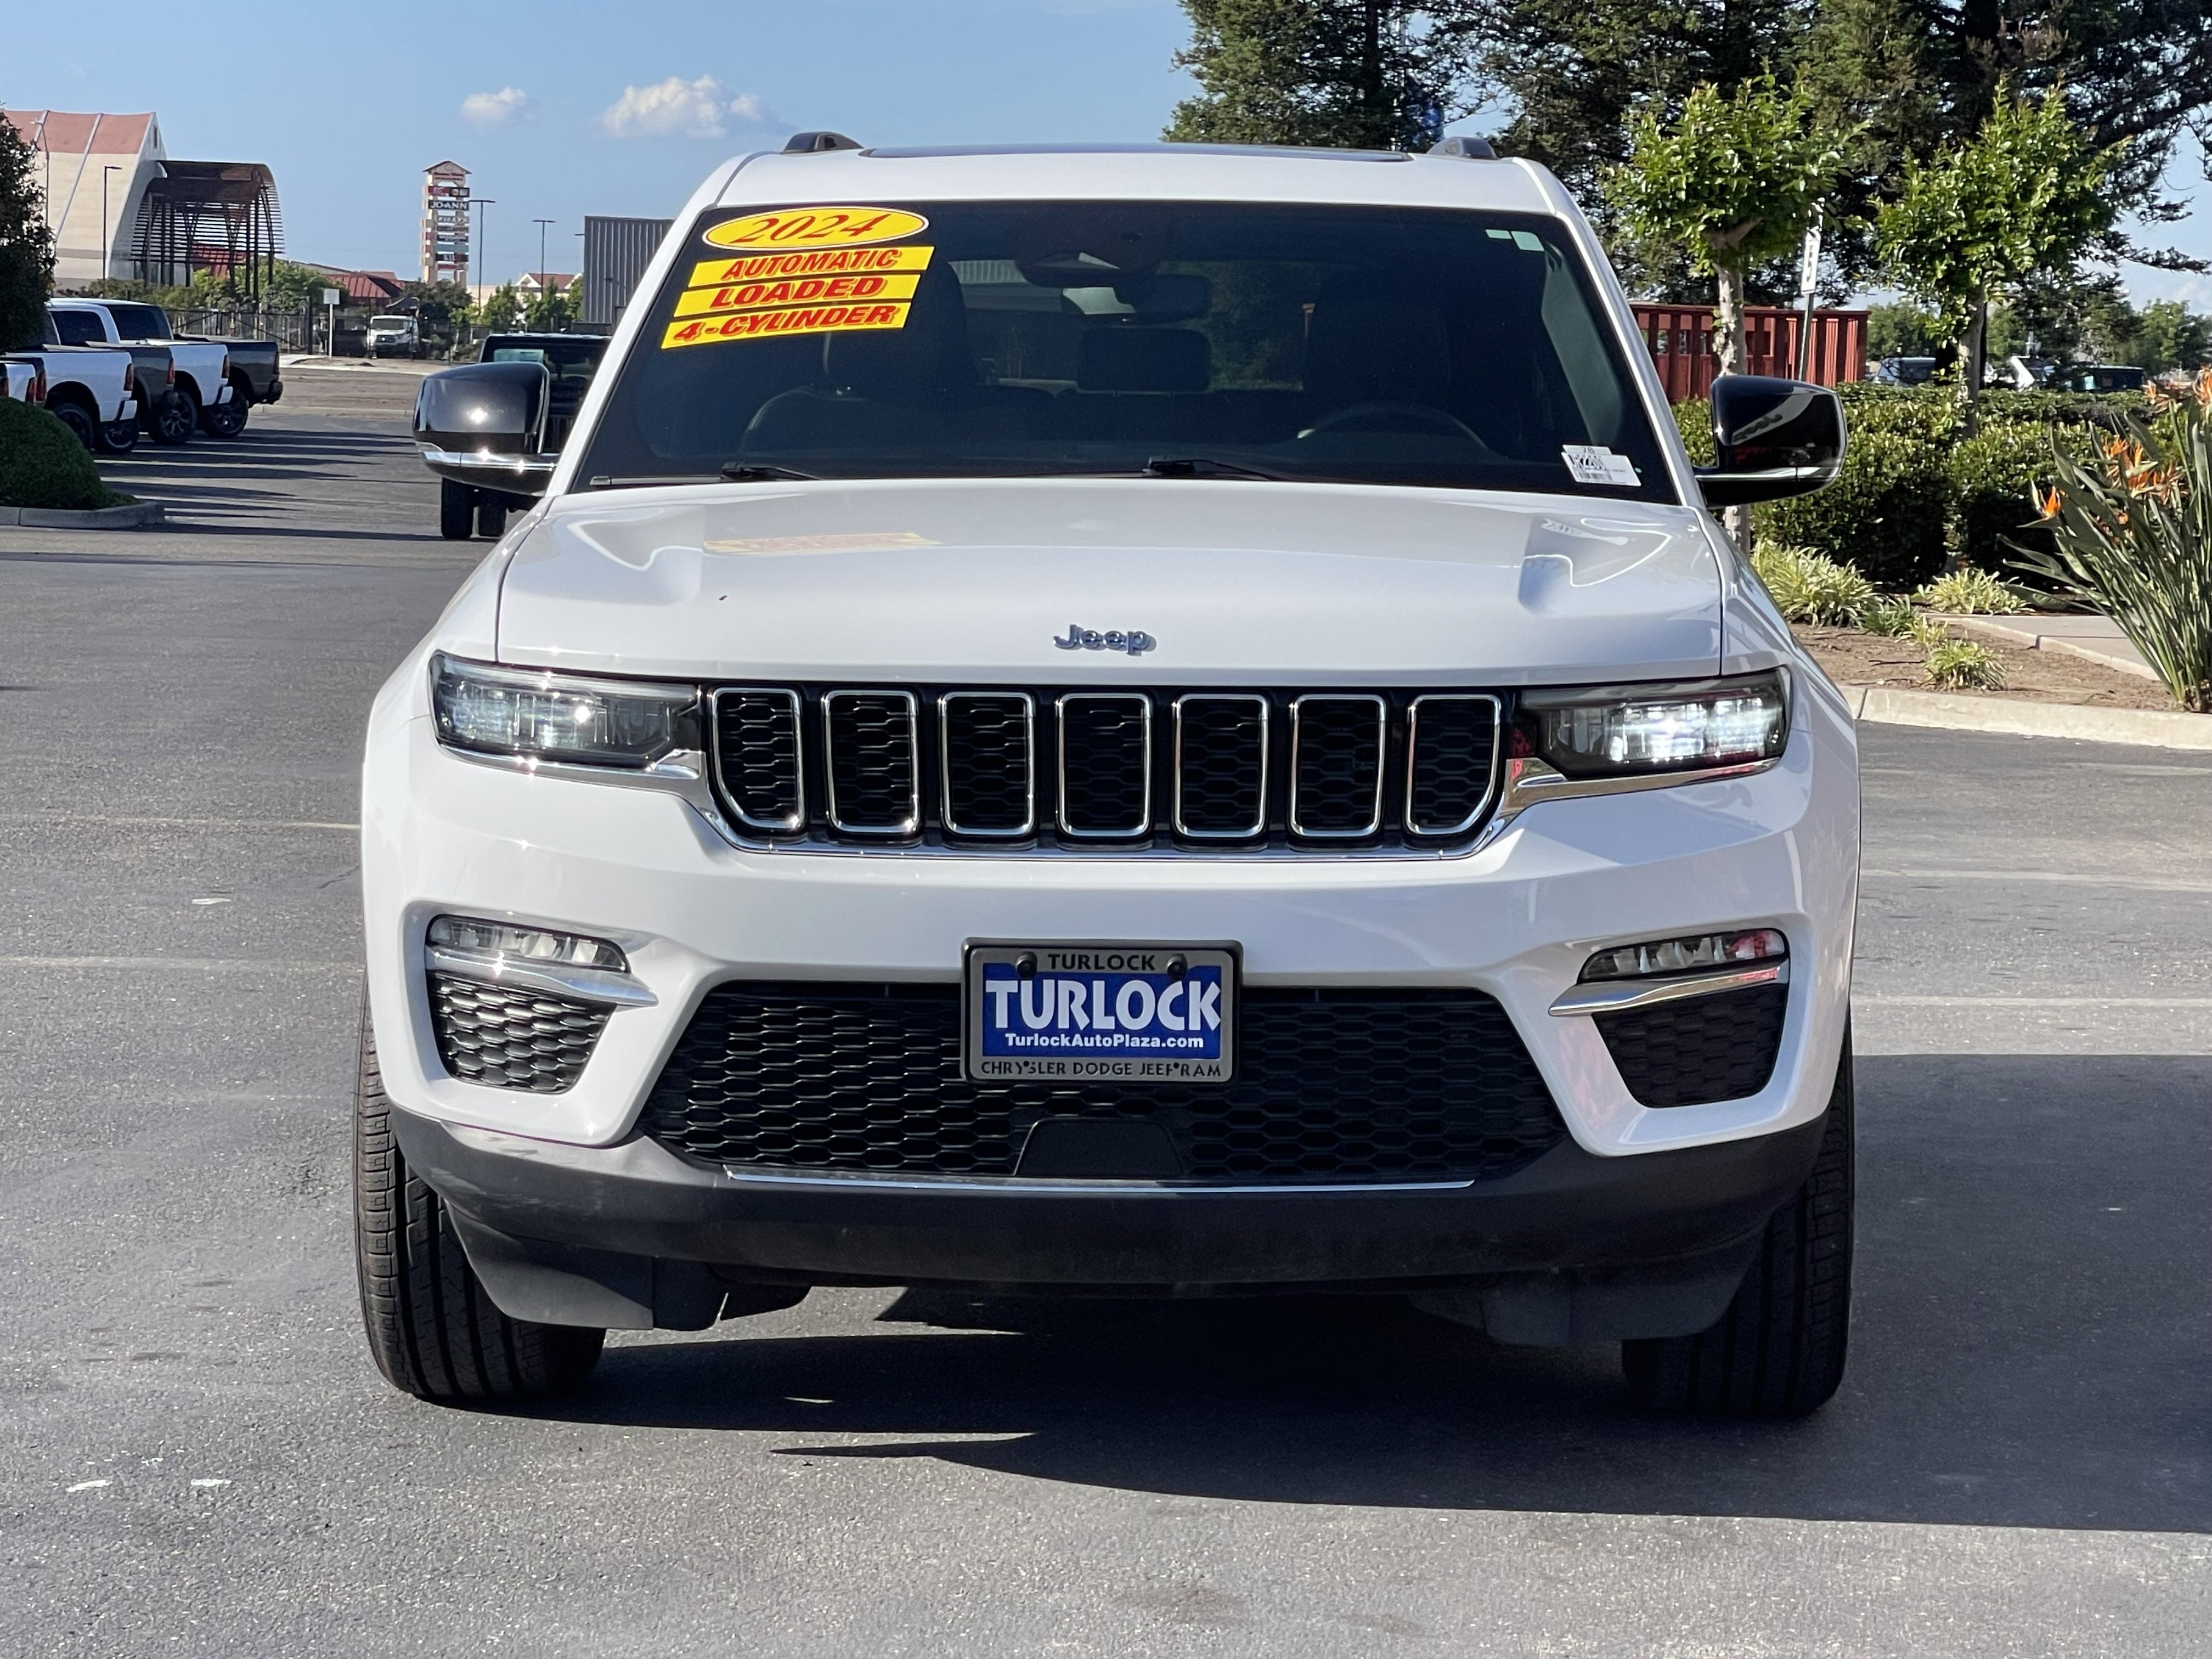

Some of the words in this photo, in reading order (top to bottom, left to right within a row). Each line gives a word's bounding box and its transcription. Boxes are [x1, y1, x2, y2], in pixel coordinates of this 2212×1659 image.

[729, 214, 892, 244] 2024
[721, 249, 902, 280] AUTOMATIC
[710, 276, 885, 309] LOADED
[673, 305, 900, 342] 4-CYLINDER
[1053, 624, 1152, 656] Jeep
[1048, 953, 1156, 971] TURLOCK
[986, 979, 1221, 1031] TURLOCK
[1005, 1032, 1204, 1048] TurlockAutoPlaza.com
[981, 1061, 1066, 1075] CHRYSLER
[1073, 1062, 1132, 1075] DODGE
[1181, 1063, 1221, 1076] RAM
